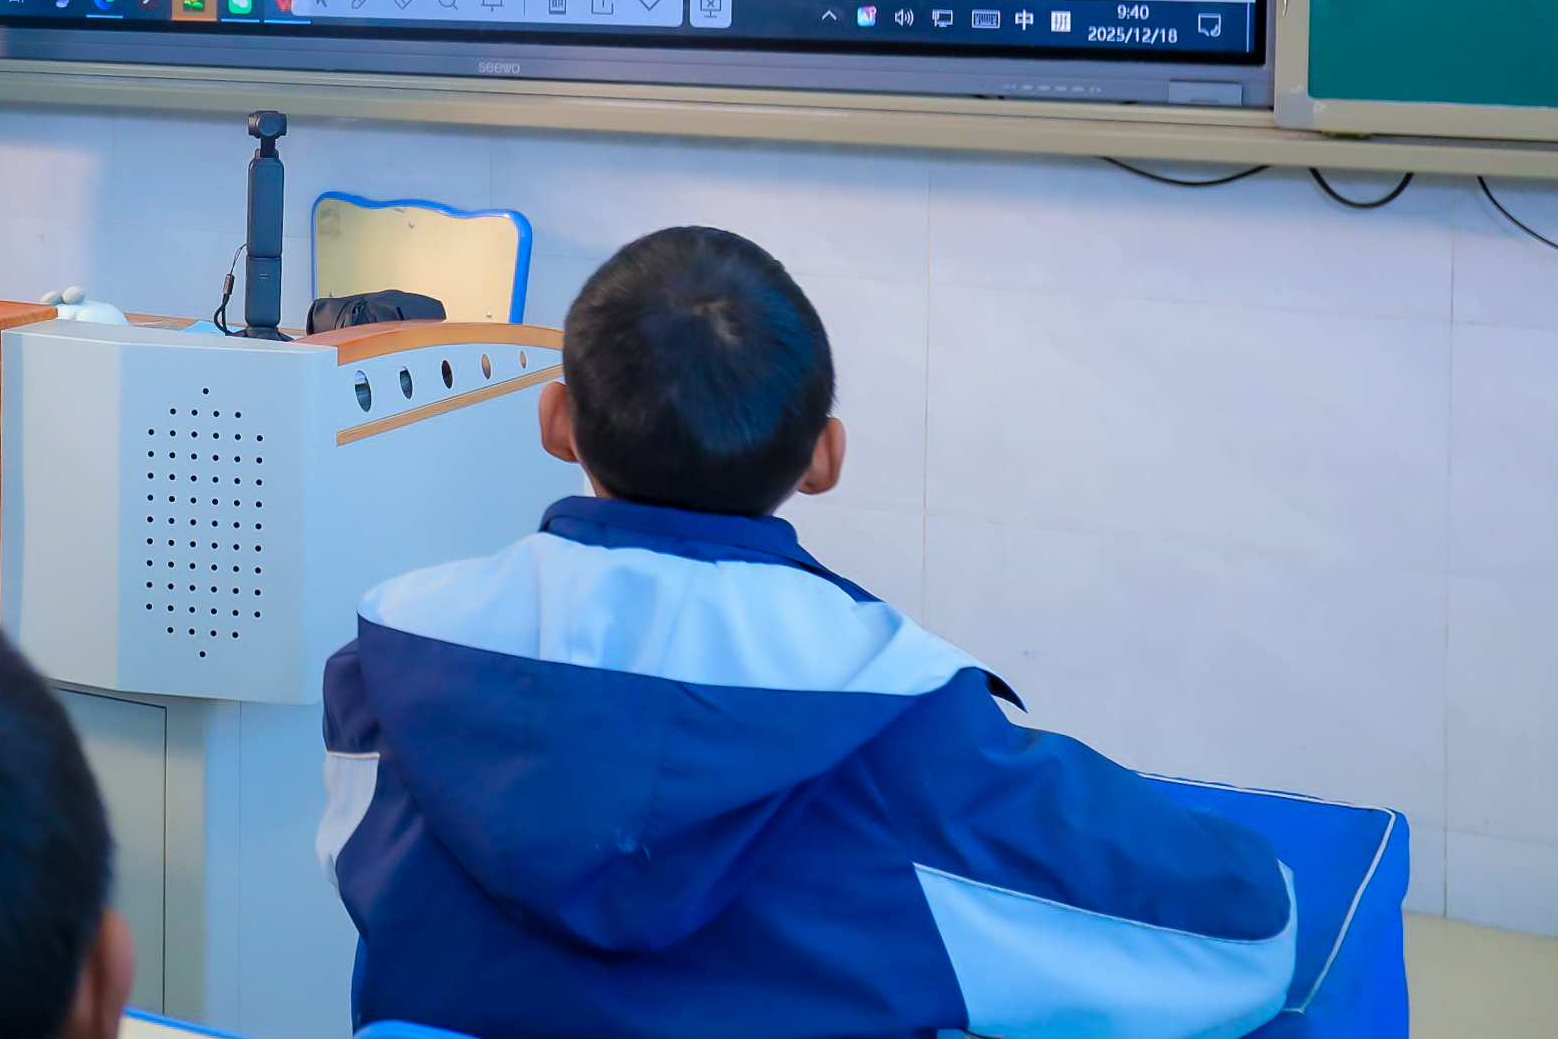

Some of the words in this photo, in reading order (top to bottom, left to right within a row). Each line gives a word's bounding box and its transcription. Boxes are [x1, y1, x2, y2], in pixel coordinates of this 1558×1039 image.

[1015, 9, 1034, 31] 中
[1117, 4, 1150, 20] 9:40
[1088, 25, 1178, 45] 2025/12/18
[478, 61, 521, 75] seewo
